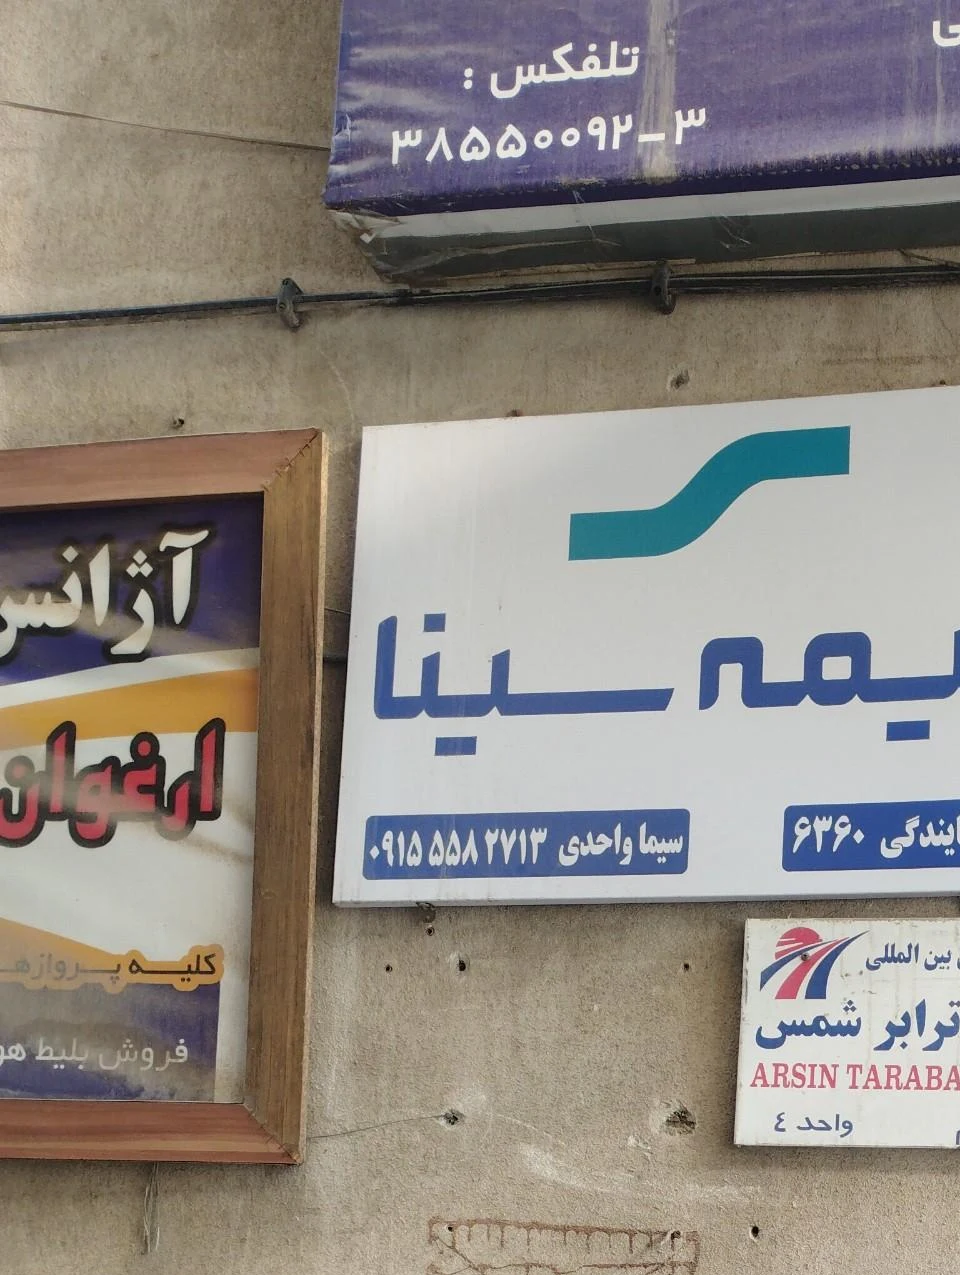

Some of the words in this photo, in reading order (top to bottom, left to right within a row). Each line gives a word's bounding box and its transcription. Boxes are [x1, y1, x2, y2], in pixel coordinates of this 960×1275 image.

[0, 529, 210, 658] آژانس
[373, 612, 675, 757] سینا
[369, 829, 423, 868] ۰۹۱۵
[428, 828, 479, 867] ۵۵۸
[484, 827, 547, 866] ۲۷۱۳
[558, 822, 633, 866] واحدی
[639, 822, 684, 864] سیما
[792, 815, 865, 854] ۶۳۶۰
[128, 953, 216, 983] کلیه
[865, 942, 919, 971] المللی
[923, 949, 951, 971] بین
[754, 999, 862, 1050] شمس
[35, 1036, 89, 1070] بلیط
[98, 1037, 189, 1072] فروش
[749, 1062, 840, 1089] ARSIN
[796, 1114, 853, 1138] واحد
